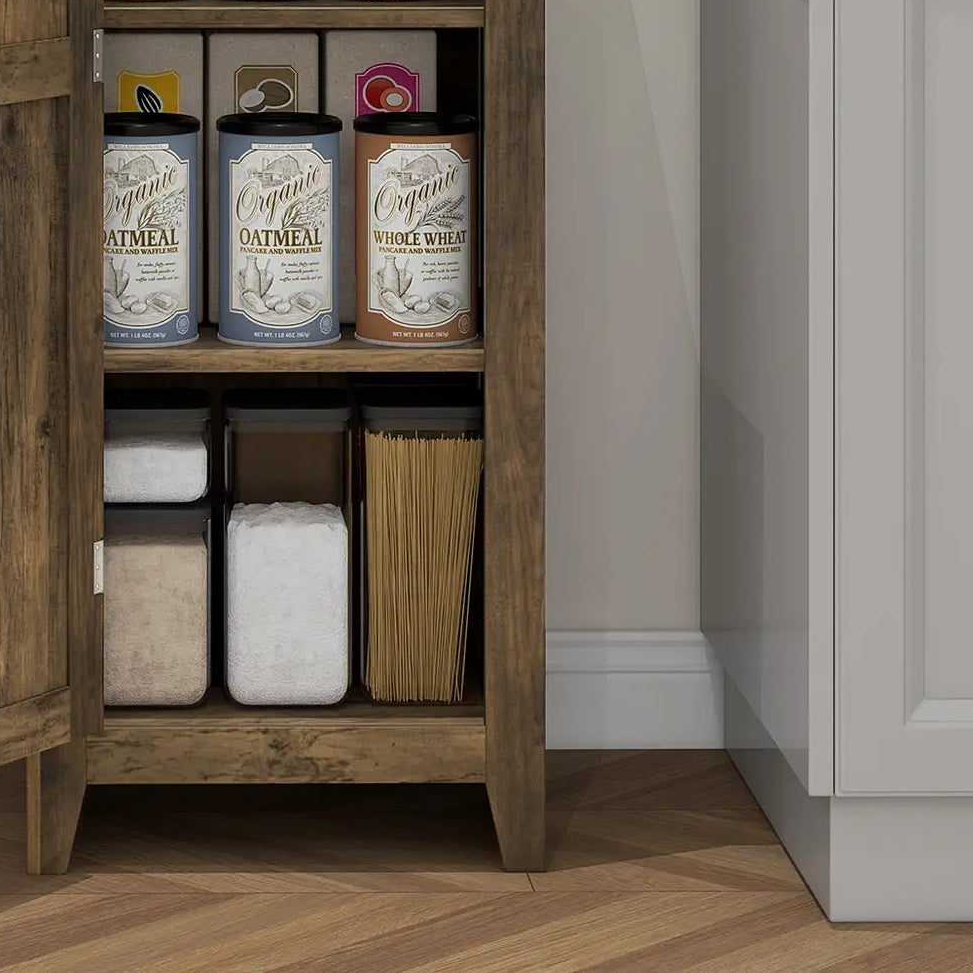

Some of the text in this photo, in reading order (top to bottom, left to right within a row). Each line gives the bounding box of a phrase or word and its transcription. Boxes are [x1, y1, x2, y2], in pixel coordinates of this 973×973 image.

[236, 164, 321, 227] Organic
[374, 164, 459, 227] Organic
[103, 228, 179, 246] ATMEAL
[239, 227, 323, 247] OATMEAL
[373, 230, 467, 246] WHOLE WHEAT
[141, 247, 166, 255] WAFFLE
[239, 247, 267, 255] PANCAKE
[285, 247, 309, 255] WAFFLE
[378, 246, 407, 254] PANCAKE
[408, 247, 424, 255] AND
